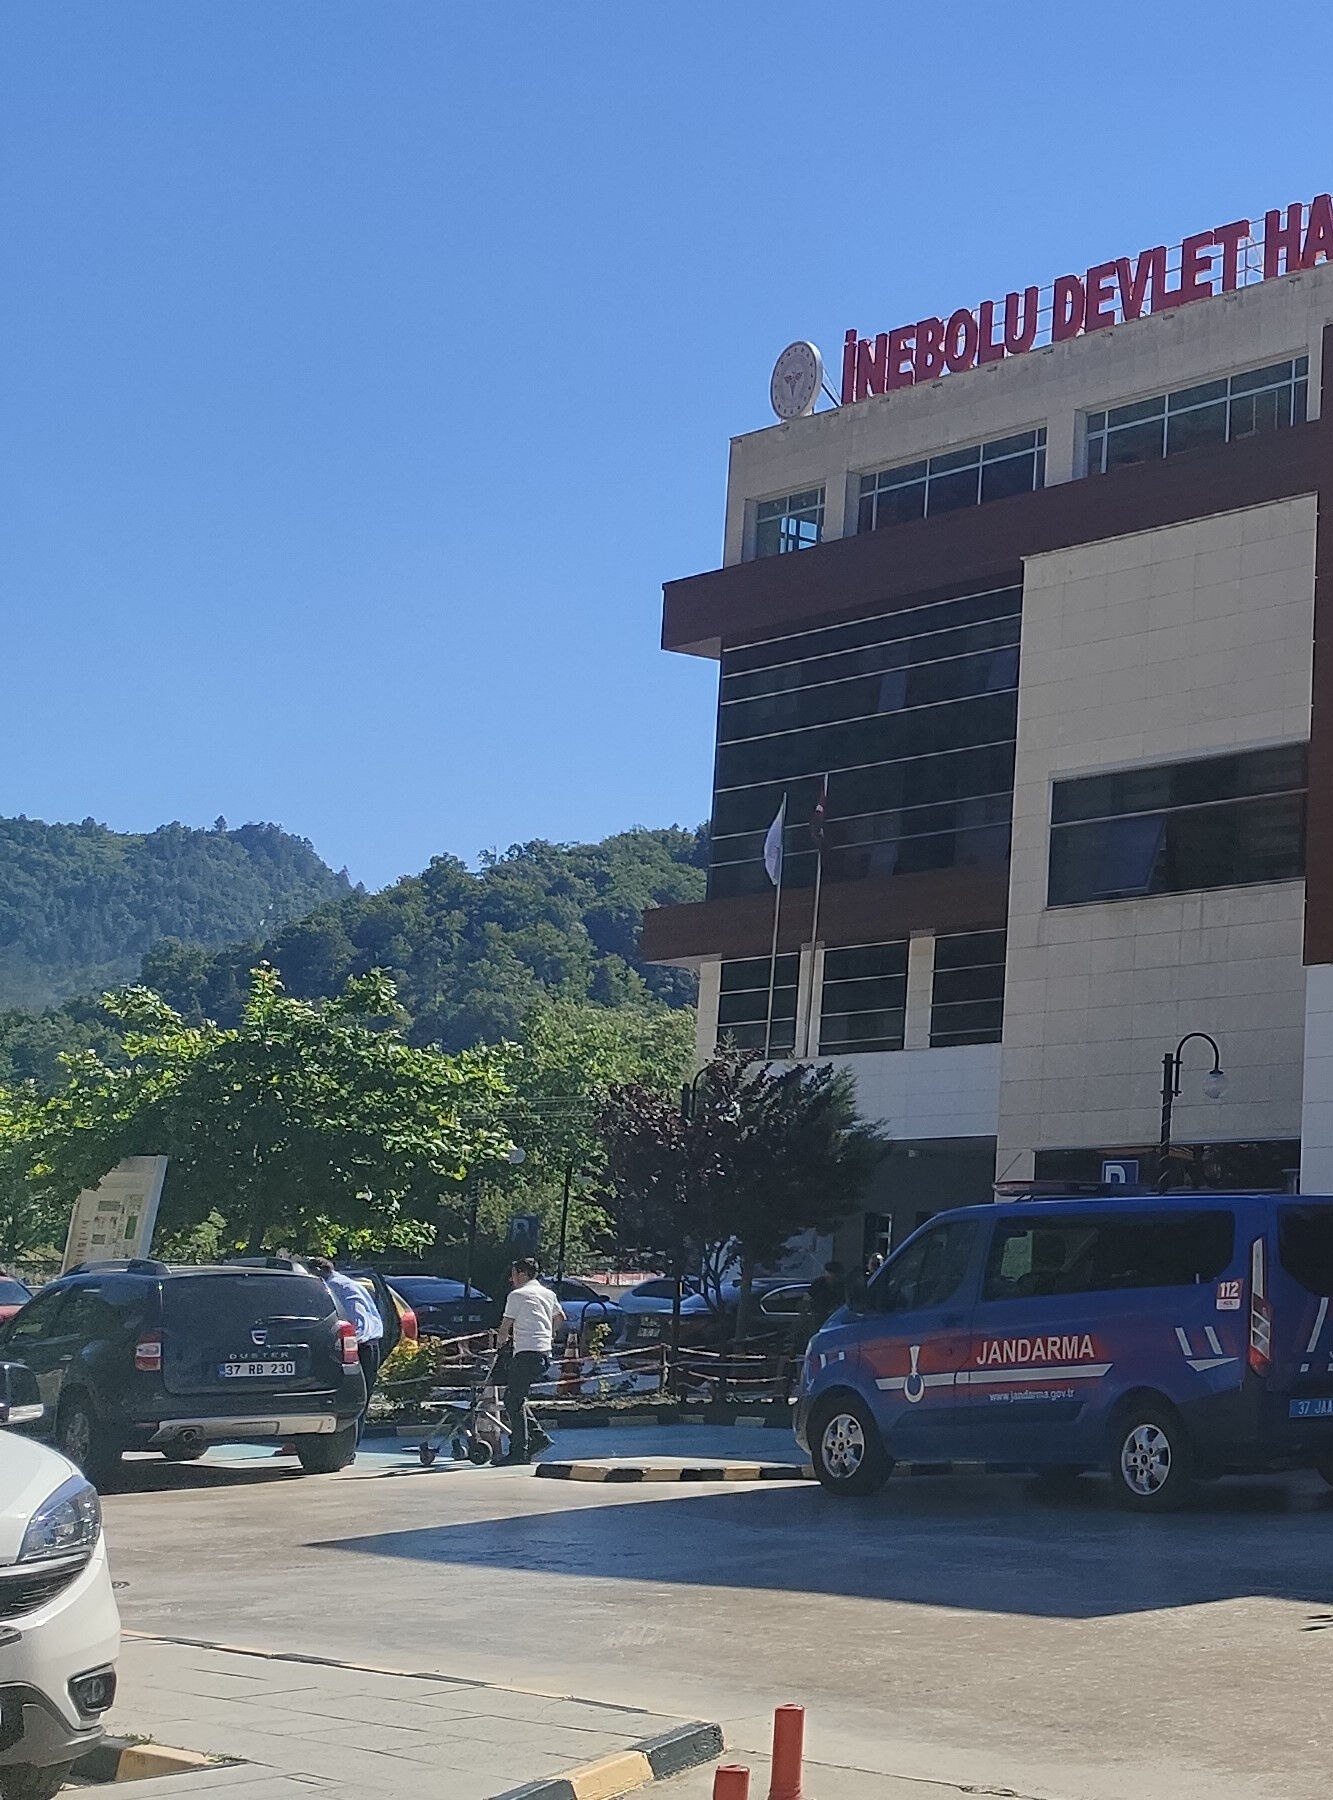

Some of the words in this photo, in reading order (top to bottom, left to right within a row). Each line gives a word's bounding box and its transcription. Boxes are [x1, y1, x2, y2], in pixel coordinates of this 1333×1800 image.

[841, 286, 1039, 405] İNEBOLU
[1052, 219, 1250, 342] DEVLET
[1220, 1281, 1239, 1298] 112
[976, 1334, 1095, 1365] JANDARMA
[226, 1365, 241, 1376] 37
[248, 1364, 264, 1375] RB
[271, 1363, 293, 1374] 230
[1298, 1402, 1310, 1415] 37
